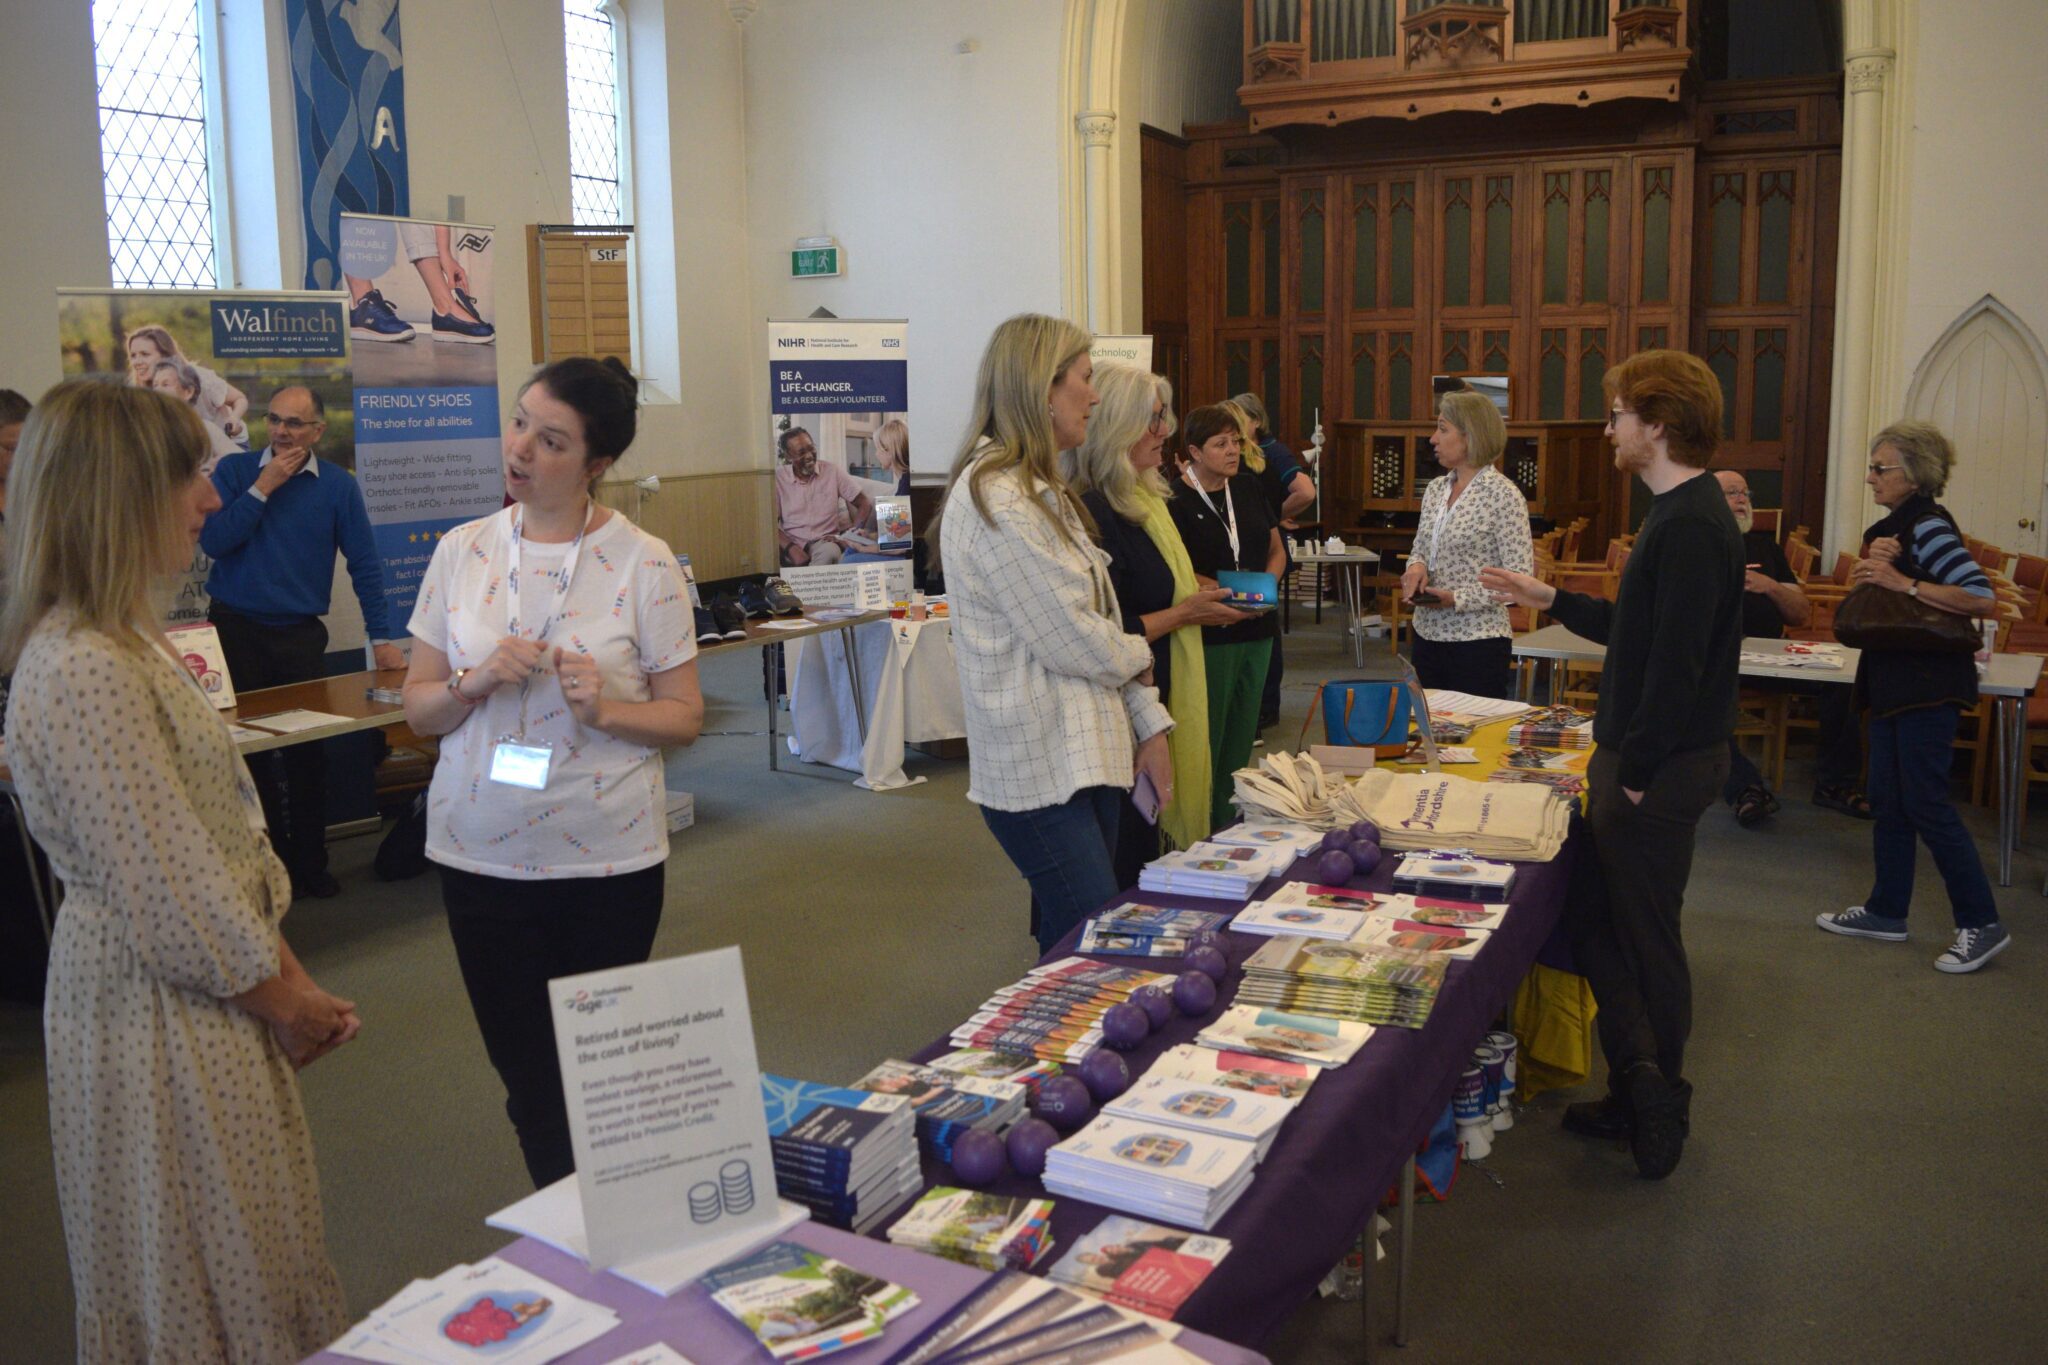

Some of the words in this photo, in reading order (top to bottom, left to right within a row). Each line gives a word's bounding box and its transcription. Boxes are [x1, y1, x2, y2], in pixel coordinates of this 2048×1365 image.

[371, 106, 400, 153] A
[597, 249, 619, 261] StF
[217, 307, 338, 333] Walfinch
[778, 338, 806, 348] NIHR
[1091, 347, 1138, 360] echnology
[780, 371, 793, 380] BE
[794, 371, 802, 380] A
[781, 382, 854, 393] LIFE-CHANGER.
[360, 394, 426, 409] FRIENDLY
[428, 393, 472, 408] SHOES
[800, 396, 840, 404] RESEARCH
[840, 395, 888, 404] VOLUNTEER.
[361, 418, 382, 429] The
[384, 417, 406, 429] shoe
[408, 417, 422, 428] for
[424, 416, 435, 427] all
[437, 415, 473, 427] abilities
[363, 455, 415, 469] Lightweight
[423, 454, 445, 464] Wide
[447, 452, 472, 464] fitting
[365, 472, 387, 483] Easy
[388, 470, 407, 480] shoe
[409, 470, 436, 479] access
[444, 468, 461, 477] Anti
[463, 466, 477, 477] slip
[478, 465, 498, 475] soles
[366, 486, 403, 498] Orthotic
[404, 484, 435, 496] friendly
[437, 482, 480, 493] removable
[367, 502, 398, 513] insoles
[405, 500, 416, 510] Fit
[418, 499, 441, 509] AFOs
[449, 496, 472, 506] Ankle
[390, 558, 402, 567] am
[404, 554, 432, 564] absolut
[395, 570, 411, 580] fact
[168, 608, 201, 622] ome
[575, 1028, 618, 1047] Retired
[621, 1023, 643, 1038] and
[645, 1013, 689, 1032] worried
[691, 1007, 725, 1023] about
[577, 1052, 598, 1065] the
[600, 1045, 624, 1060] cost
[627, 1040, 641, 1054] of
[642, 1033, 681, 1051] living?
[581, 1079, 606, 1092] Even
[608, 1069, 644, 1083] though
[645, 1067, 664, 1079] you
[665, 1062, 687, 1073] may
[687, 1056, 711, 1068] have
[584, 1089, 621, 1105] modest
[664, 1080, 671, 1088] a
[671, 1067, 723, 1086] retirement
[586, 1105, 623, 1121] income
[625, 1102, 635, 1112] or
[638, 1098, 658, 1109] own
[659, 1092, 682, 1106] your
[684, 1086, 705, 1098] own
[605, 1117, 634, 1131] worth
[636, 1106, 681, 1124] checking
[682, 1102, 690, 1113] if
[690, 1097, 720, 1113] you're
[590, 1131, 630, 1150] entitled
[631, 1130, 642, 1141] to
[644, 1120, 683, 1136] Pension
